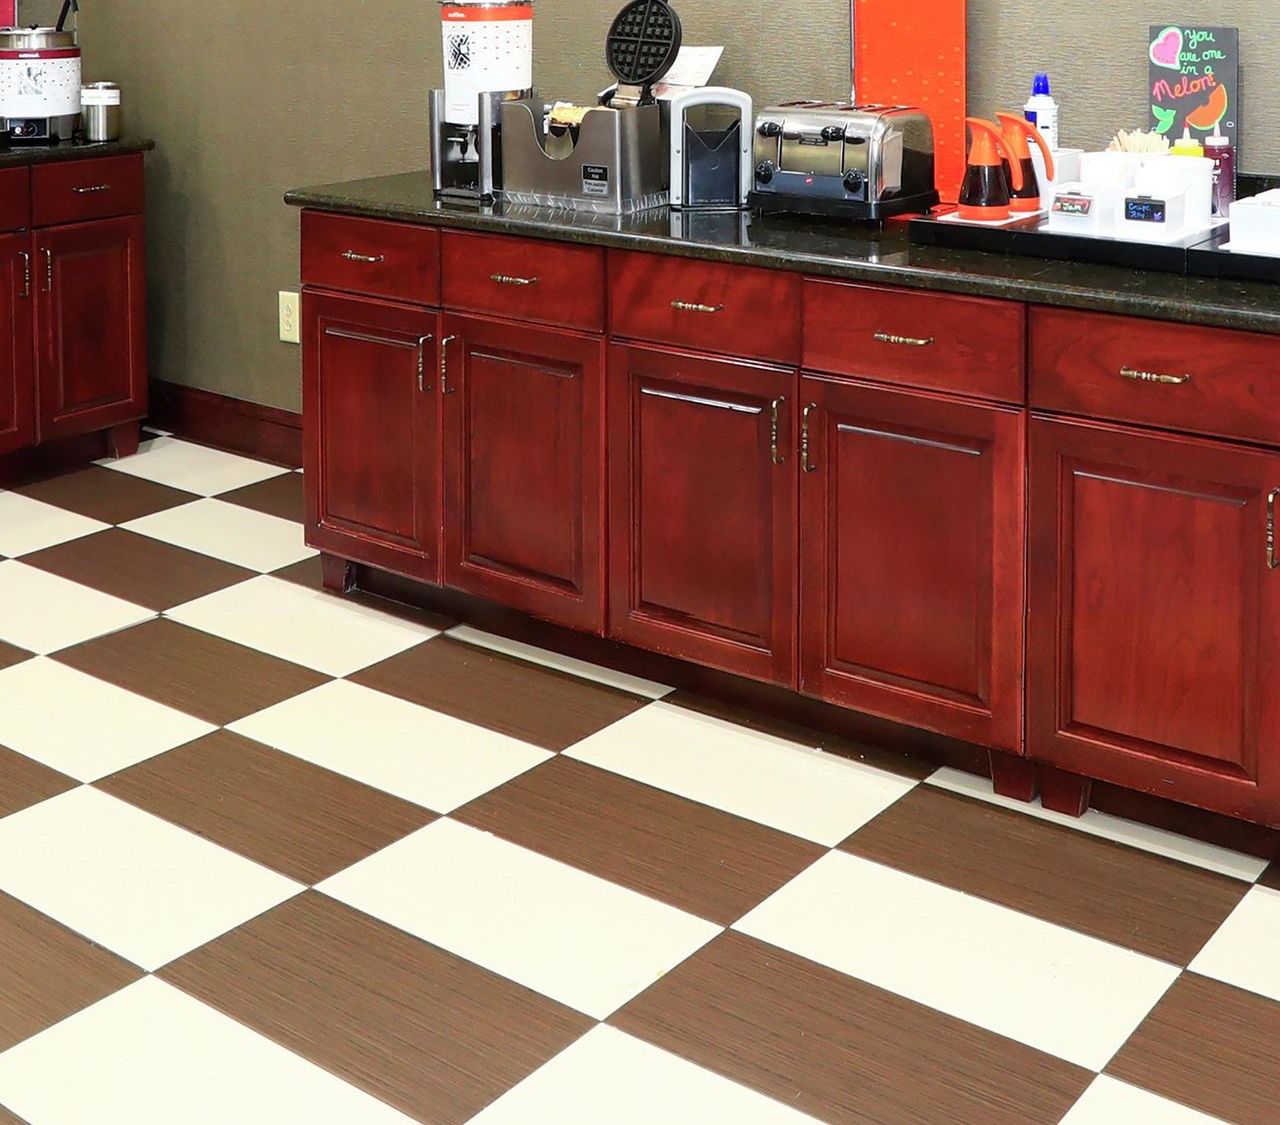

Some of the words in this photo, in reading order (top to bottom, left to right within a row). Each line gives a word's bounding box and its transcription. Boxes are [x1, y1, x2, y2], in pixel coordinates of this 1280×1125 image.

[1180, 52, 1201, 62] are
[1202, 50, 1226, 60] one
[1180, 62, 1199, 75] in
[1204, 65, 1214, 75] a
[1153, 74, 1216, 102] Melon!
